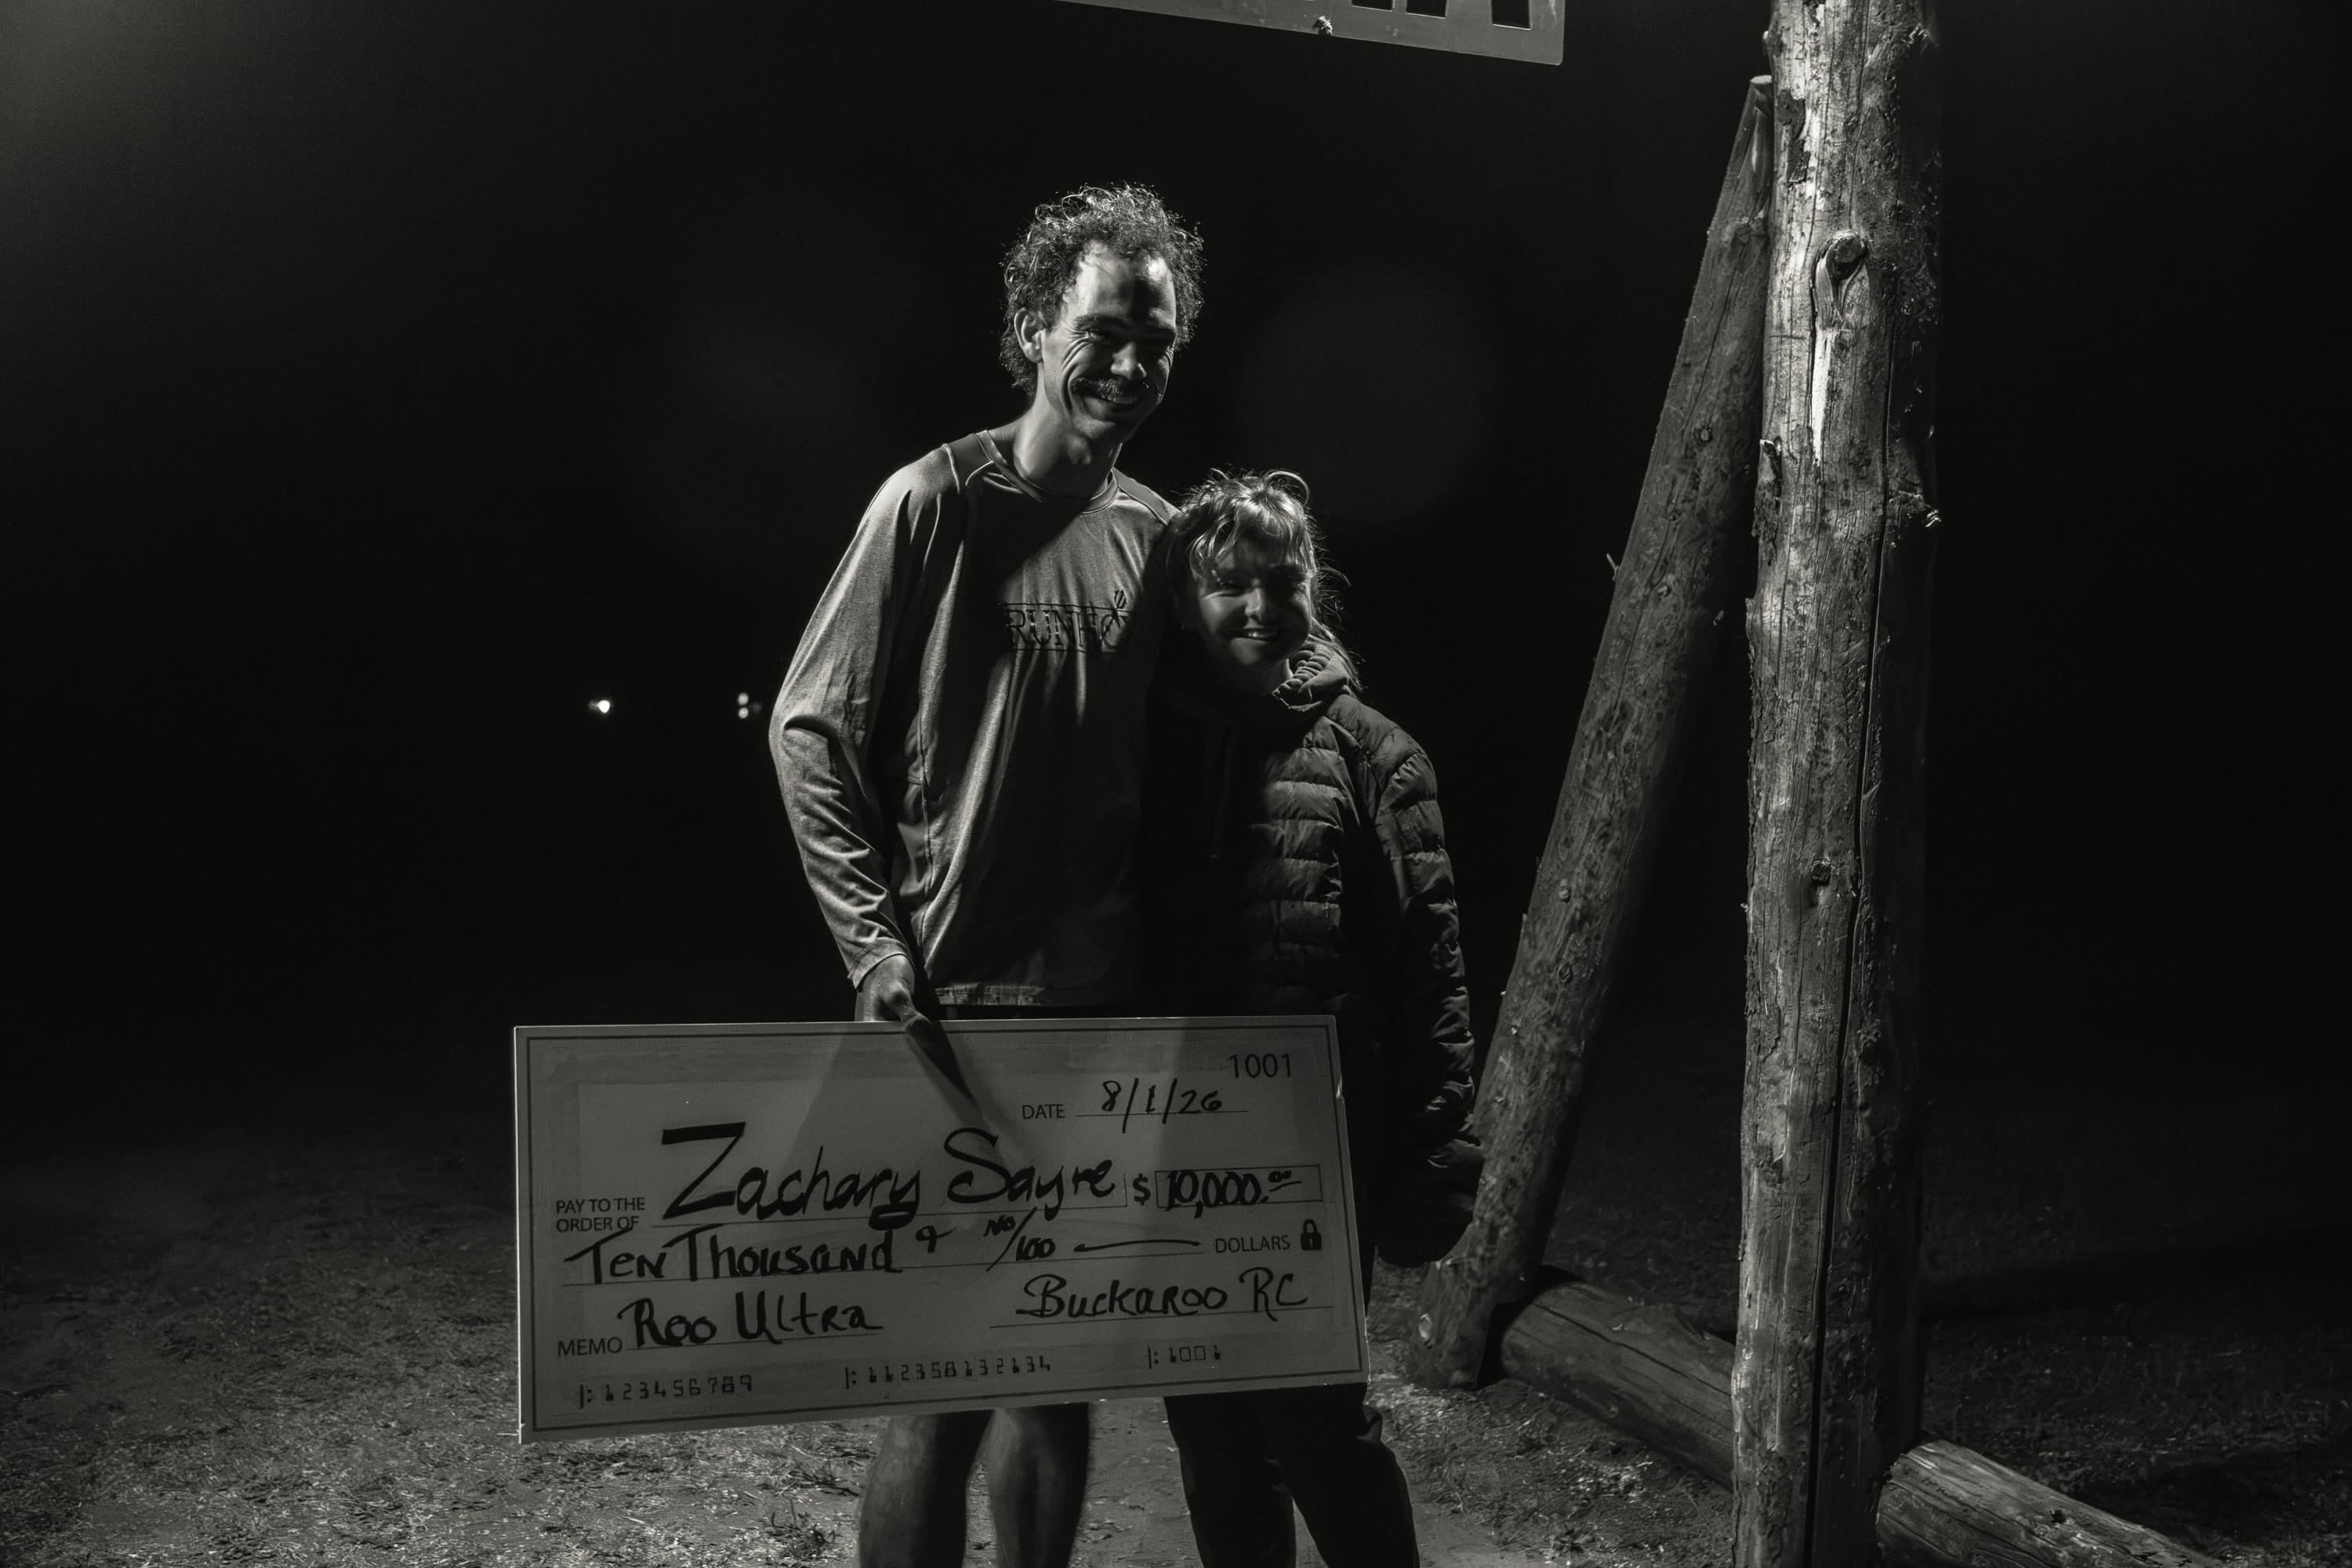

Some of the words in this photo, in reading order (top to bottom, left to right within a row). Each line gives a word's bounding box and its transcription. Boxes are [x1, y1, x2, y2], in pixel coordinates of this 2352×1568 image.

[1229, 1053, 1292, 1078] 1001
[1022, 1104, 1066, 1120] DATE
[1101, 1077, 1223, 1134] 8/1/26
[661, 1121, 921, 1230] Zachary
[943, 1127, 1116, 1221] Sayre
[1132, 1174, 1151, 1206] $
[556, 1199, 586, 1214] PAY
[589, 1198, 612, 1213] TO
[614, 1196, 646, 1211] THE
[555, 1216, 613, 1233] ORDER
[616, 1215, 640, 1231] OF
[1214, 1235, 1290, 1254] DOLLARS
[1239, 1265, 1308, 1322] RC
[617, 1297, 717, 1350] Roo
[557, 1337, 623, 1358] MEMO
